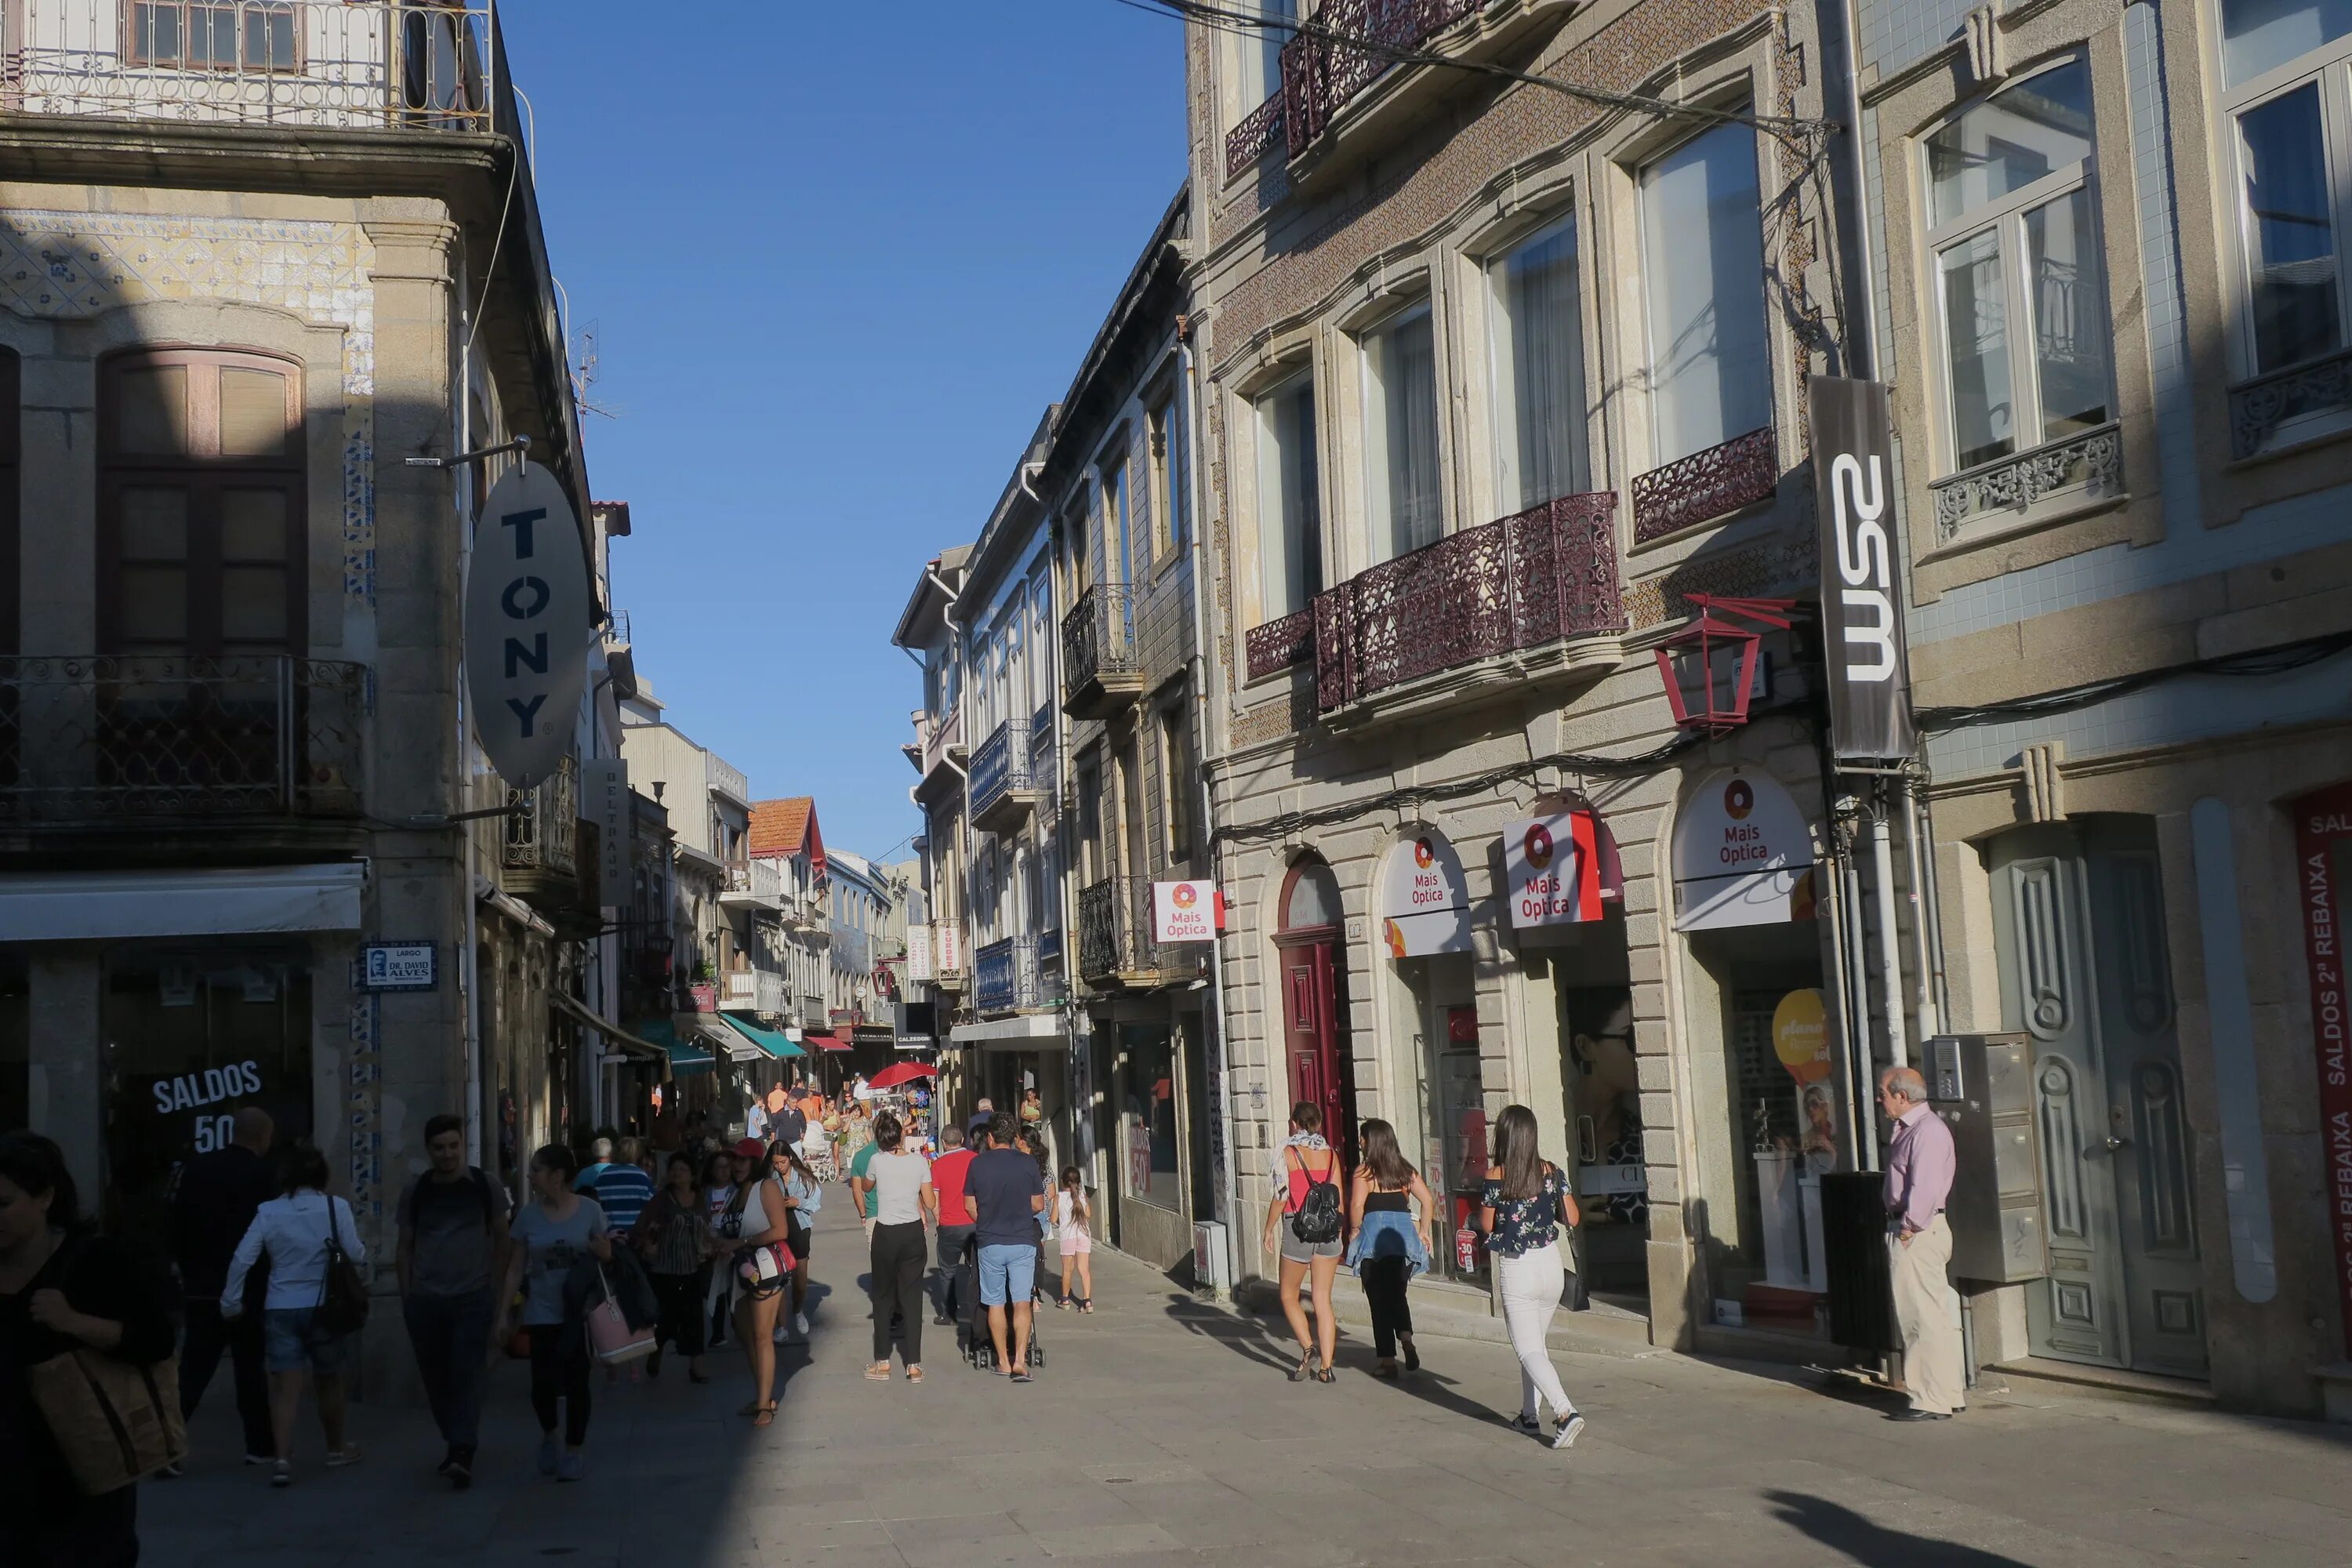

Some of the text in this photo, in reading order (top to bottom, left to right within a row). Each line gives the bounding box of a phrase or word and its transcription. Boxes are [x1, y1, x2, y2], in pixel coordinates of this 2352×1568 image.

[500, 507, 550, 739] TONY
[1724, 824, 1760, 843] Mais
[1719, 841, 1767, 866] Optica
[1414, 873, 1439, 888] Mais
[1526, 874, 1561, 895] Mais
[1412, 887, 1443, 906] Optica
[1522, 895, 1570, 921] Optica
[2307, 852, 2335, 956] REBAIXA
[1167, 924, 1207, 937] Optica
[1172, 912, 1201, 924] Mais
[945, 929, 954, 968] SURDEZ
[2321, 990, 2346, 1086] SALDOS
[152, 1059, 261, 1114] SALDOS
